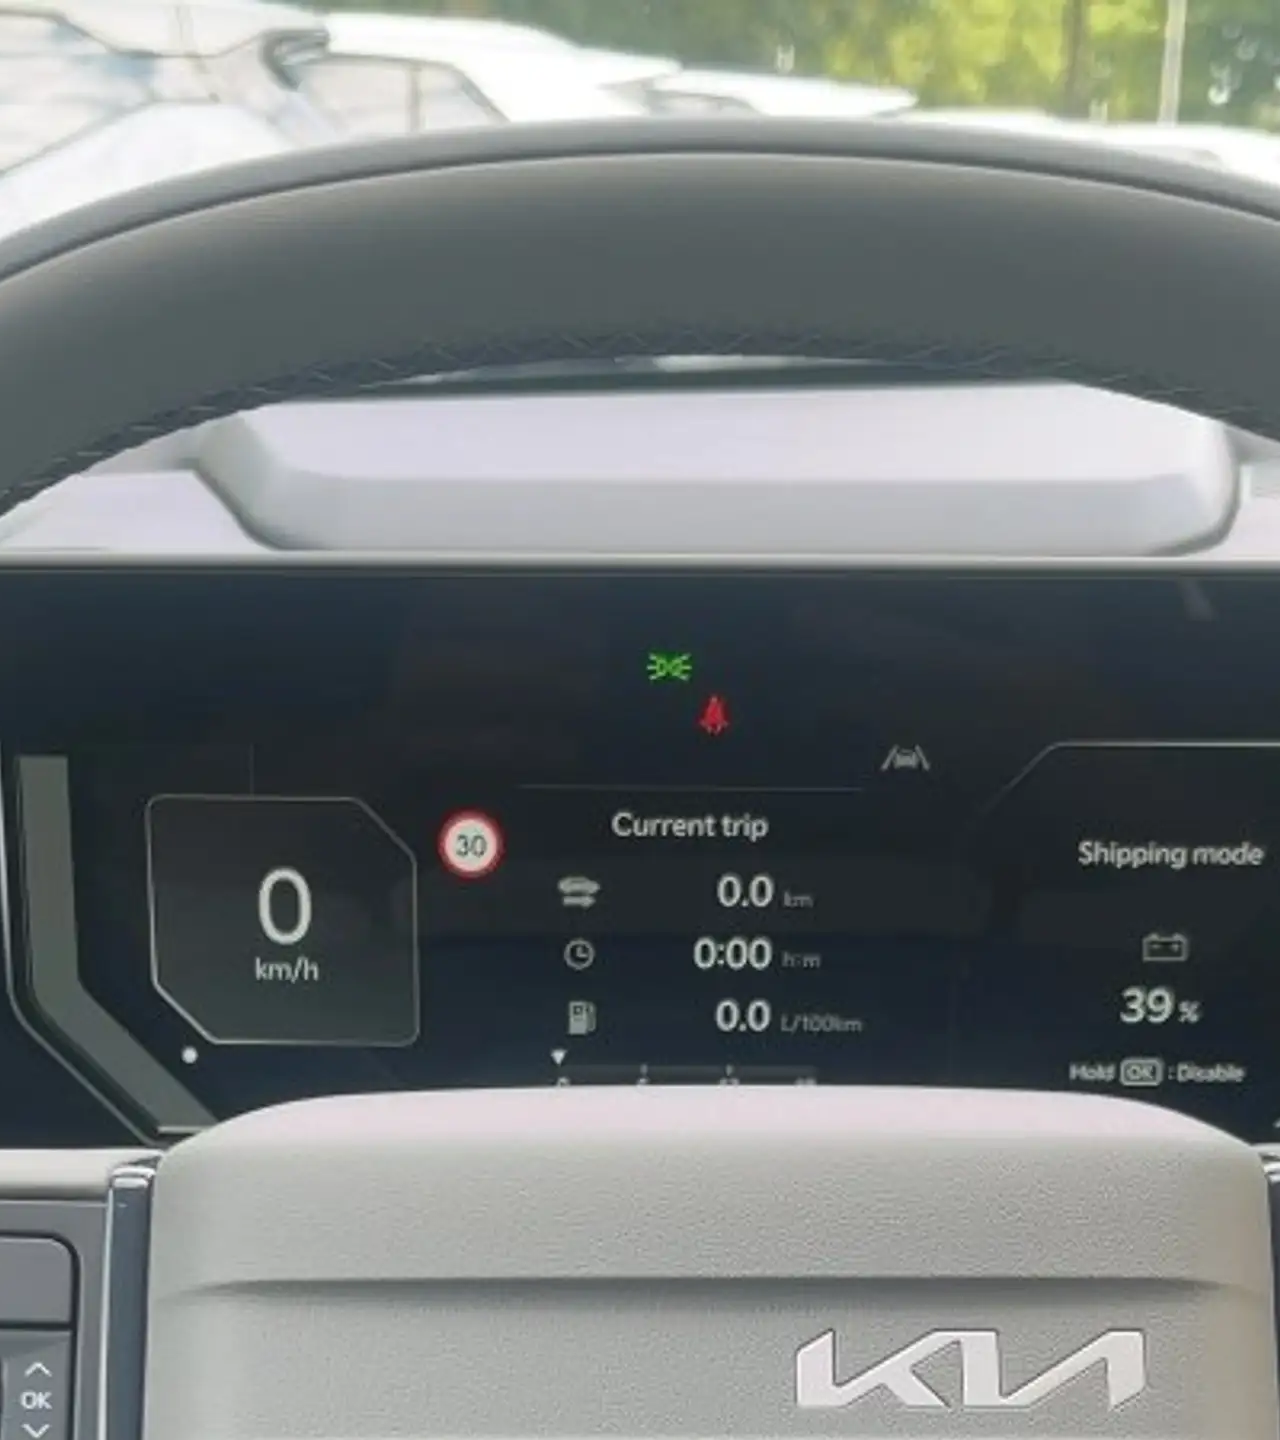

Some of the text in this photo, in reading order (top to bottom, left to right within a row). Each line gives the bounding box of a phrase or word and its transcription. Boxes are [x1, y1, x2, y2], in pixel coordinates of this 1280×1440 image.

[611, 812, 770, 841] Current trip
[455, 833, 487, 857] 30
[1078, 841, 1264, 870] Shipping mode
[717, 874, 774, 908] 0.0
[258, 867, 312, 945] 0
[693, 937, 772, 970] 0:00
[255, 957, 319, 982] km/h
[716, 999, 771, 1033] 0.0
[21, 1390, 51, 1410] OK
